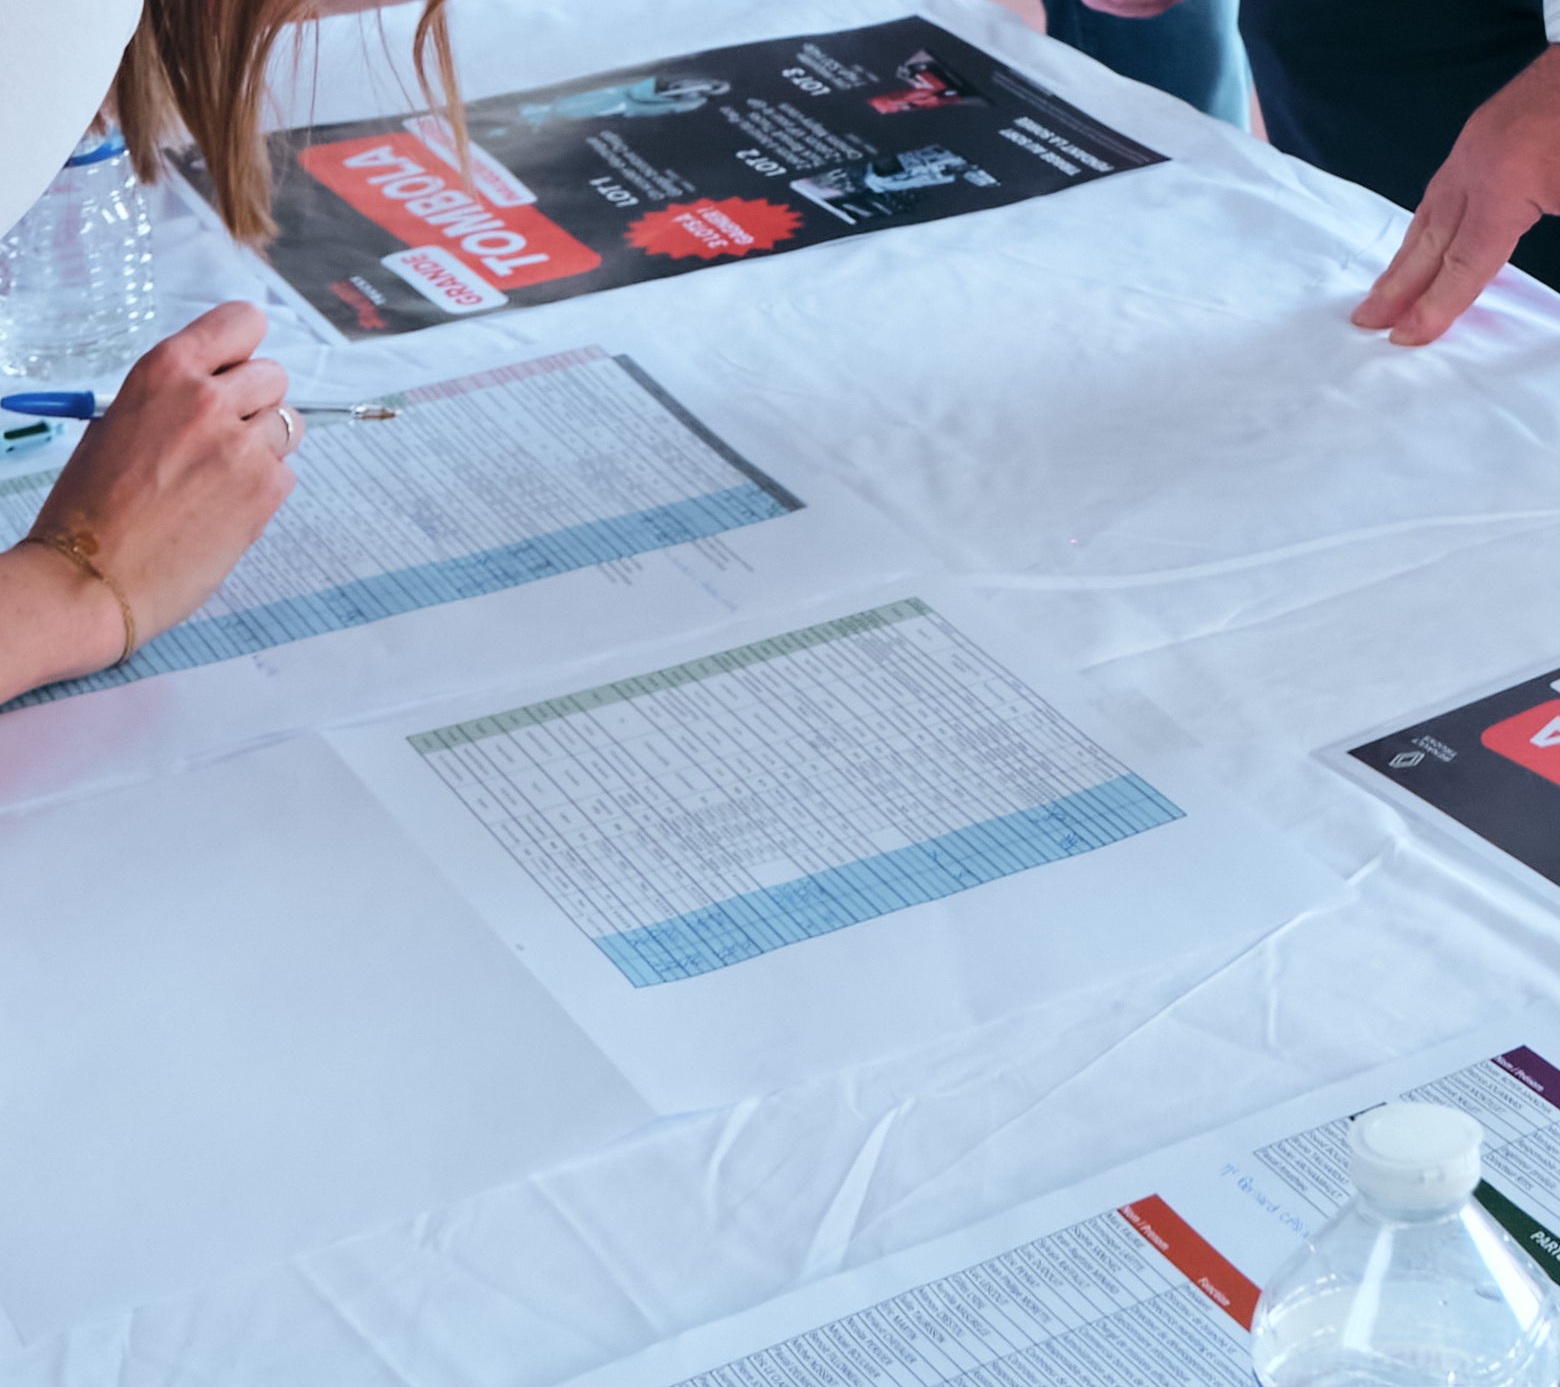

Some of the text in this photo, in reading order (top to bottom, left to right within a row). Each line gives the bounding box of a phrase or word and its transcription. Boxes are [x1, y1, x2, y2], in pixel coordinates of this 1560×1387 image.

[787, 74, 835, 96] LOT
[742, 154, 791, 177] LOT
[596, 183, 642, 208] LOT
[336, 143, 555, 277] TOMBOLA
[679, 218, 723, 242] LOTS
[400, 251, 487, 307] GRANDE
